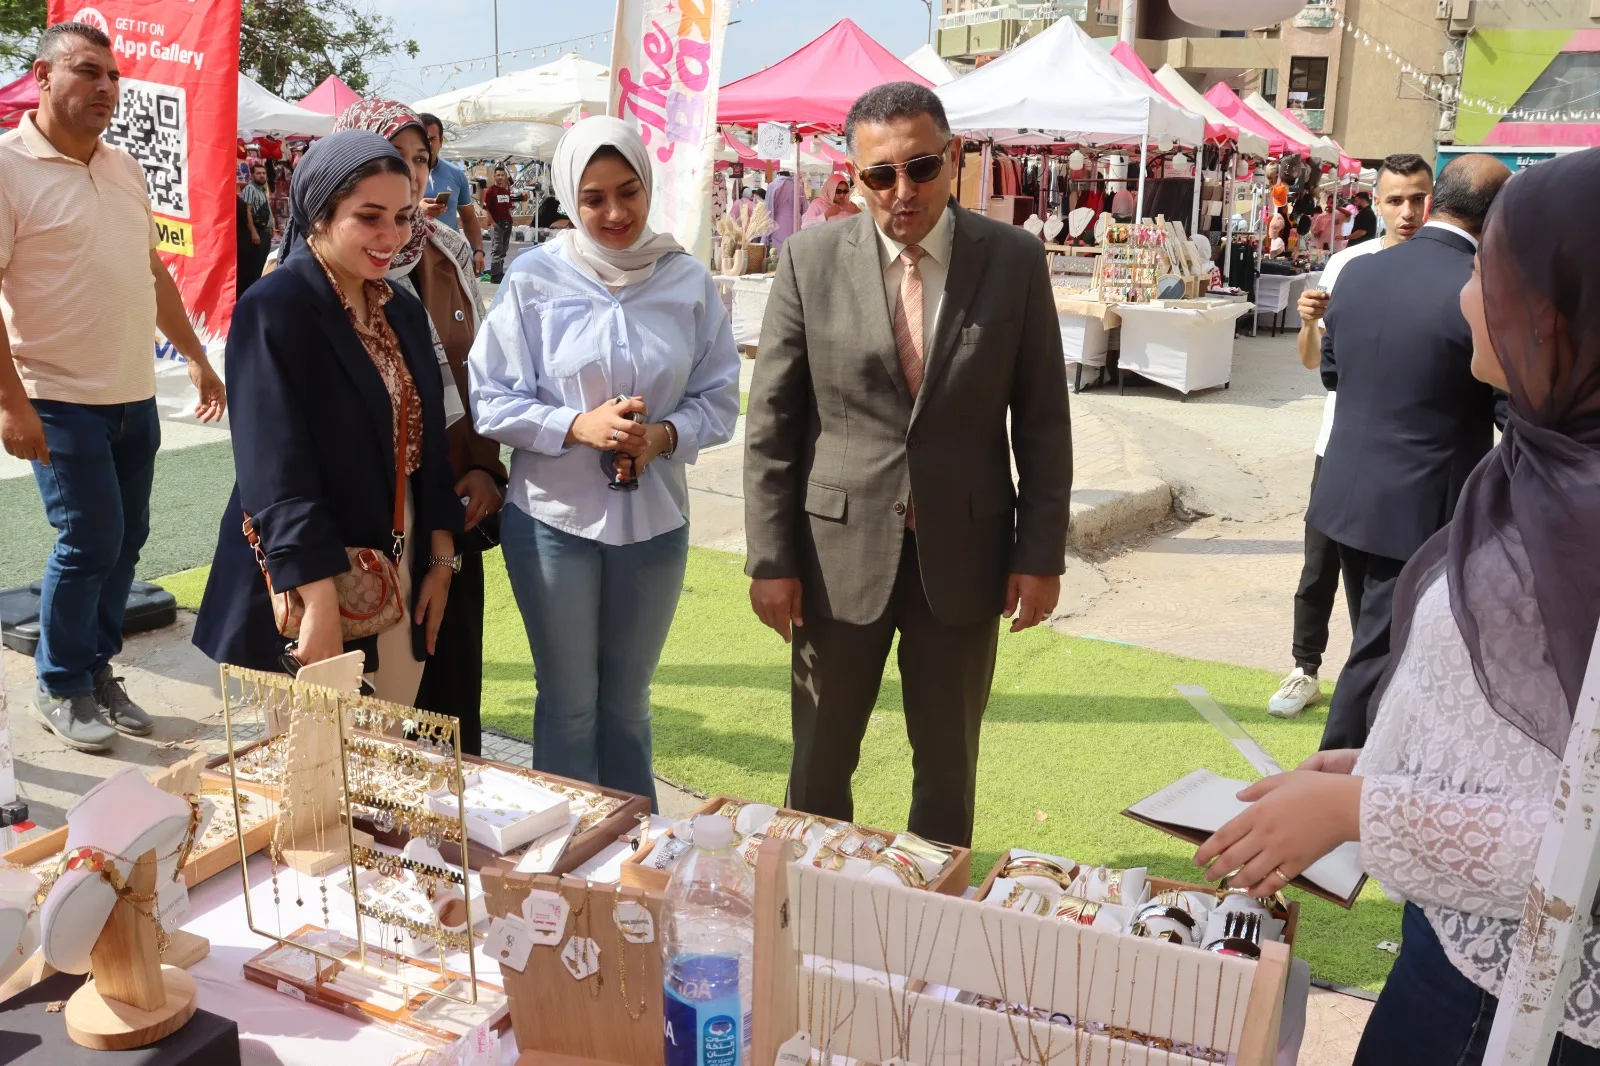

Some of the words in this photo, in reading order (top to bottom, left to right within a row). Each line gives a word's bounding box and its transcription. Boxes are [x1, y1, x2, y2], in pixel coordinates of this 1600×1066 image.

[115, 17, 135, 31] GET
[137, 21, 149, 34] IT
[150, 24, 165, 36] ON
[113, 34, 147, 61] App
[150, 40, 205, 71] Gallery
[618, 20, 675, 163] The
[156, 222, 185, 247] Me!
